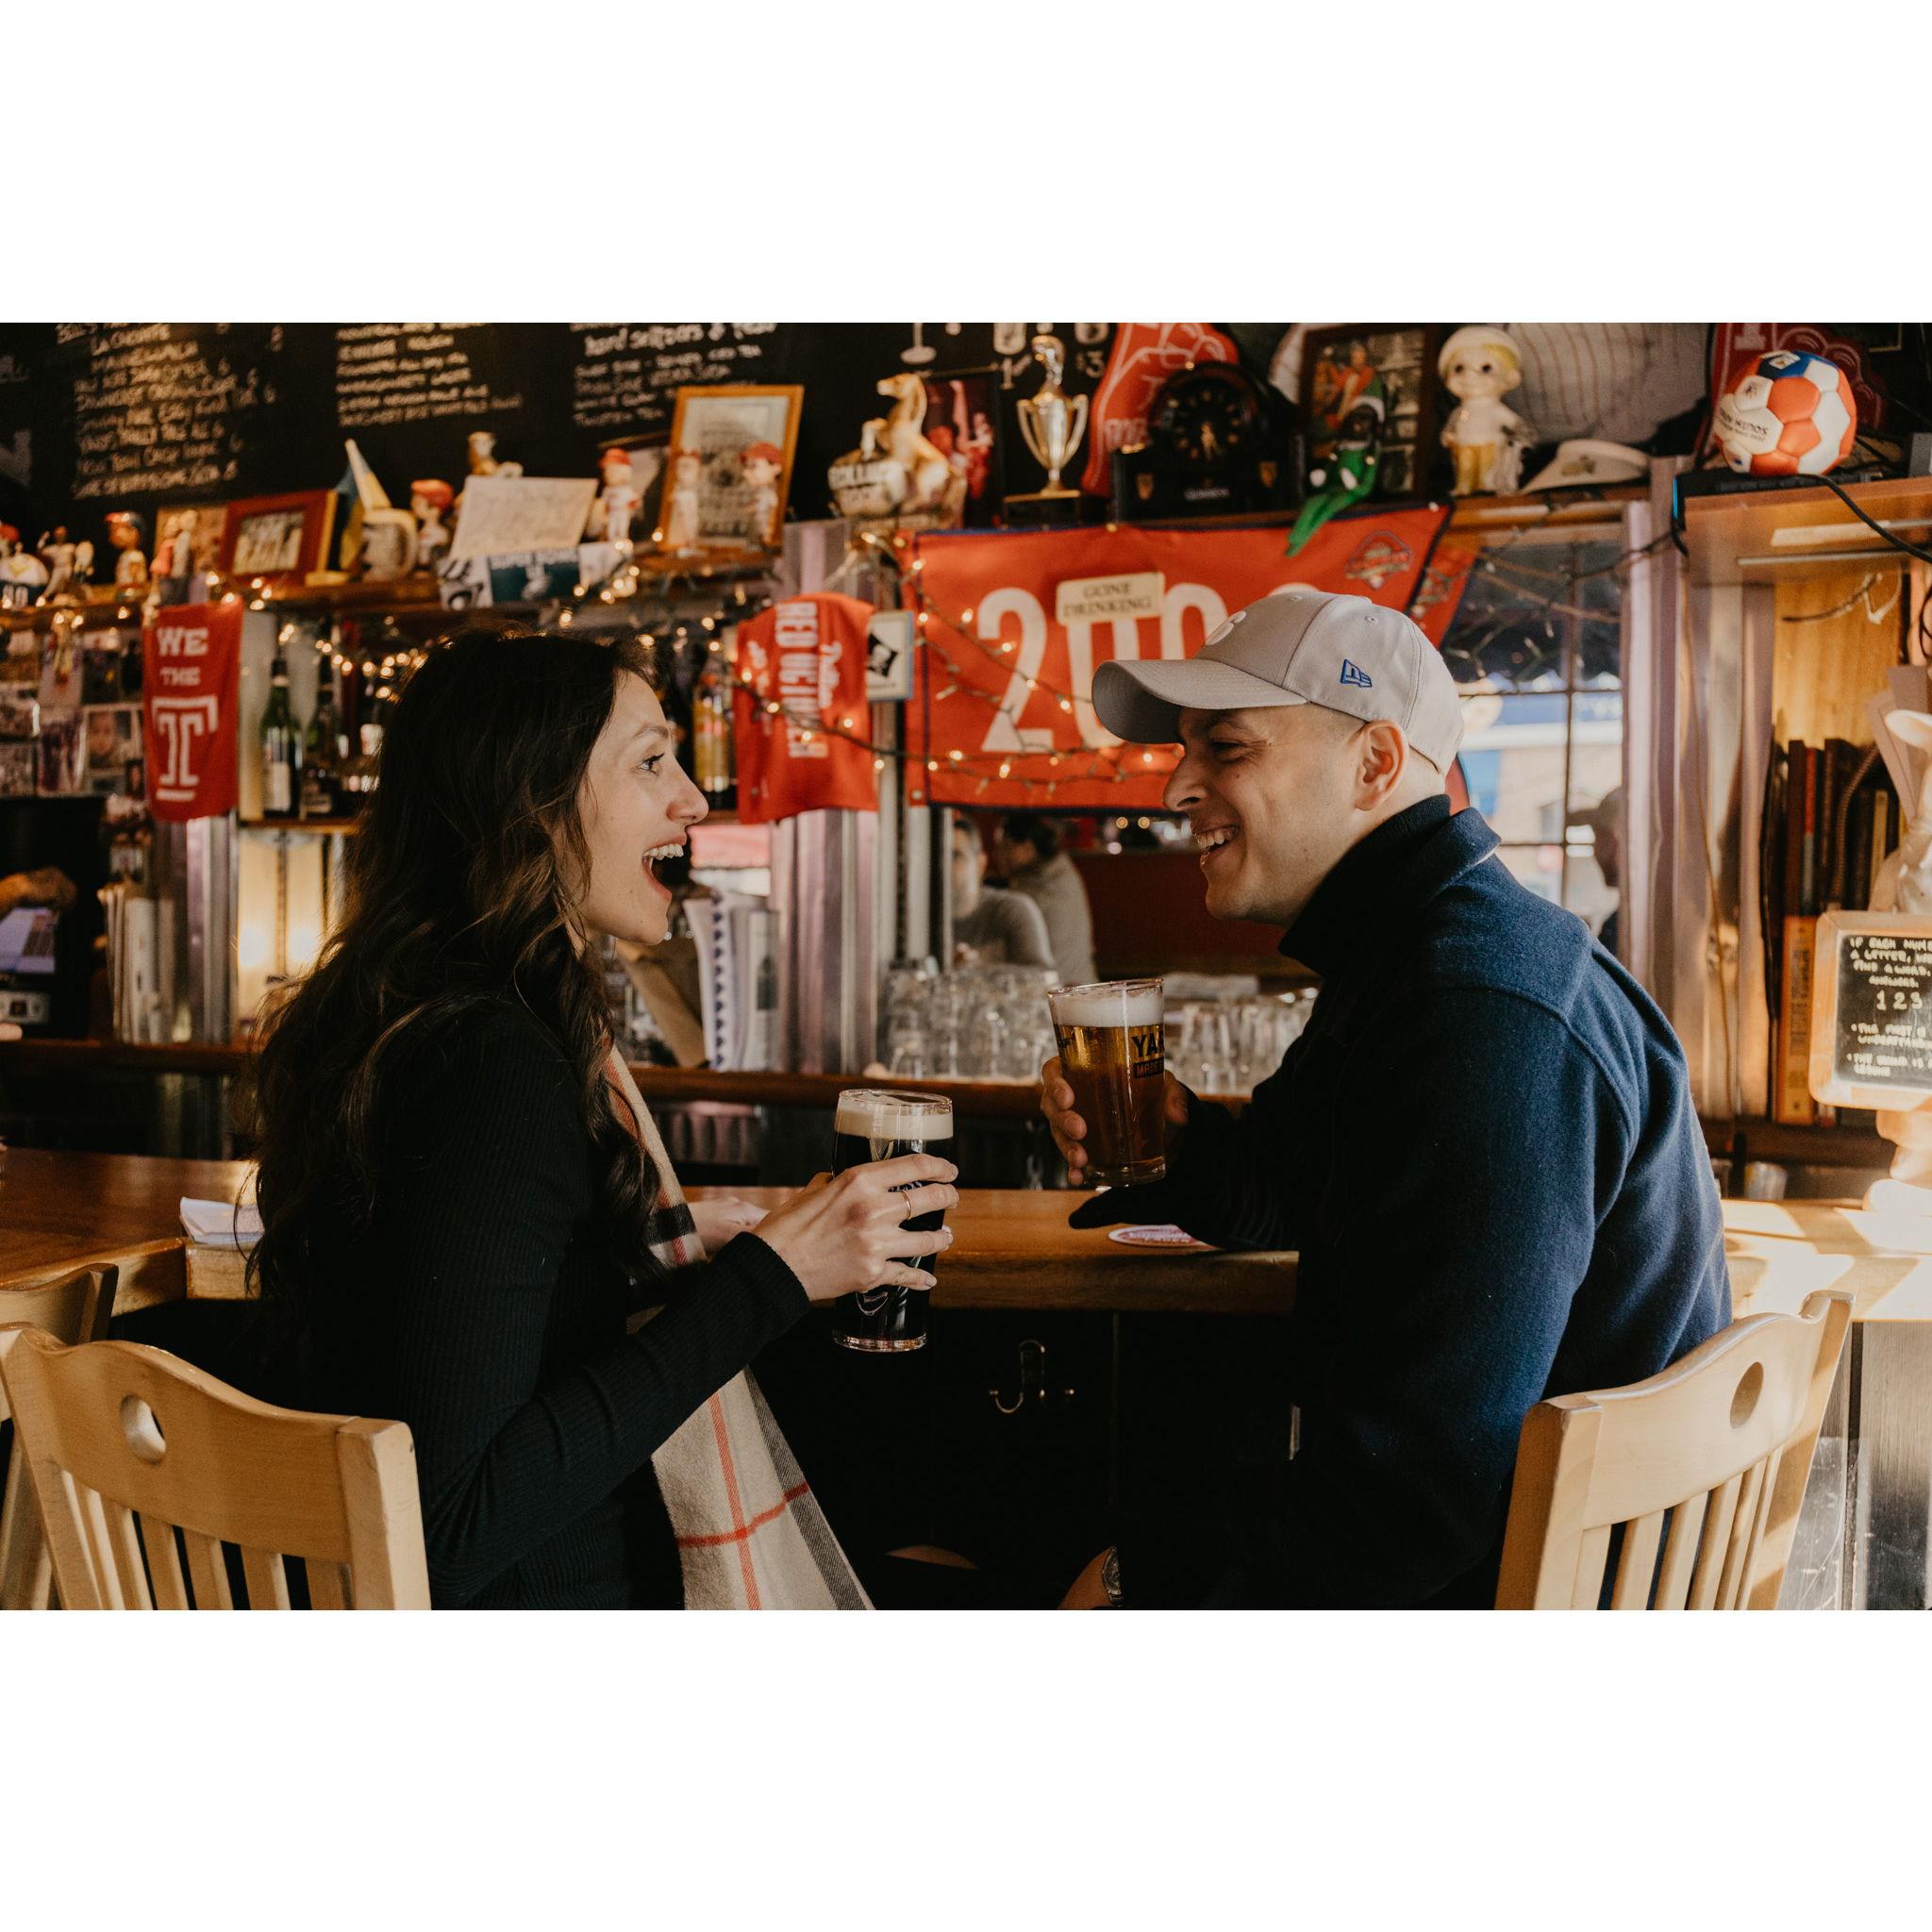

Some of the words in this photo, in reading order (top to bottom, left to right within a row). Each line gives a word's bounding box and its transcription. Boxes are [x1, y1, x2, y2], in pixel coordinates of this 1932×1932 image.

[1083, 583, 1130, 598] GONE
[1063, 596, 1152, 618] DRINKING
[157, 626, 209, 657] WE
[159, 666, 201, 687] THE
[1876, 991, 1887, 1011] 1
[1893, 991, 1907, 1010] 2
[1910, 991, 1923, 1009] 3
